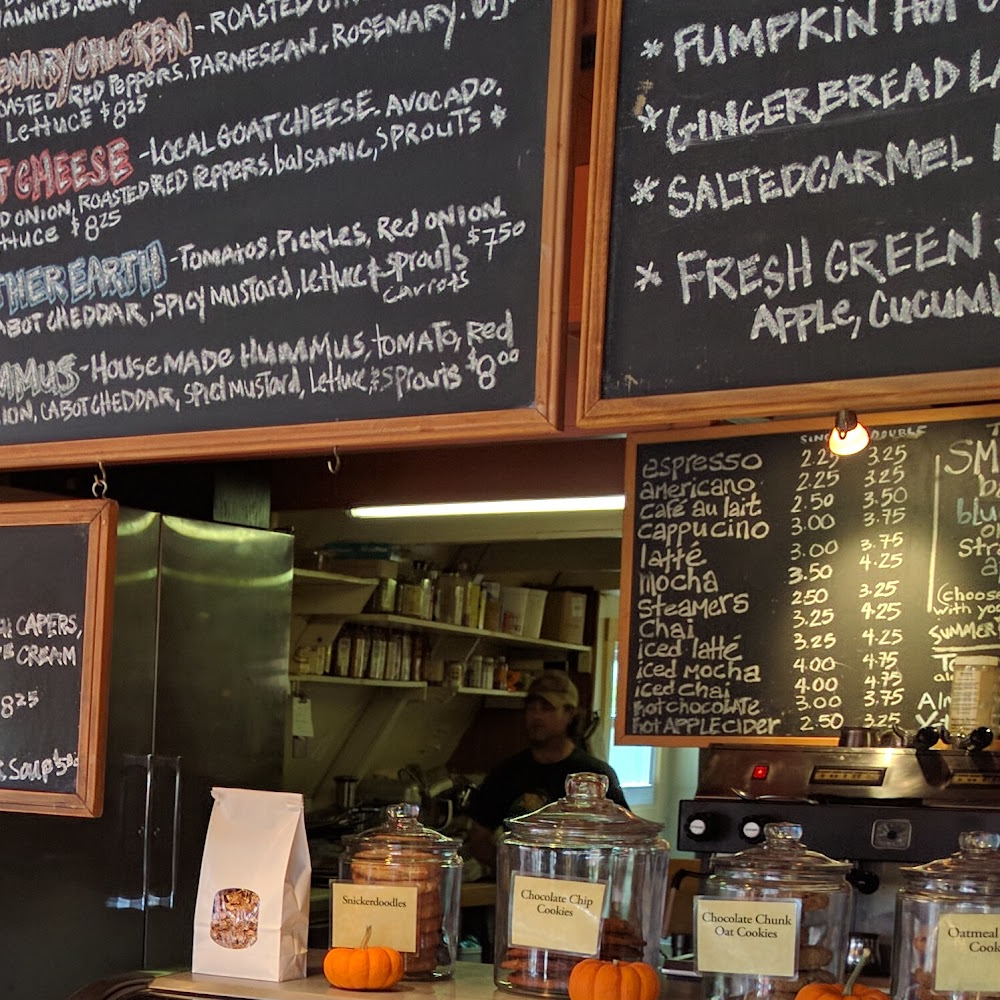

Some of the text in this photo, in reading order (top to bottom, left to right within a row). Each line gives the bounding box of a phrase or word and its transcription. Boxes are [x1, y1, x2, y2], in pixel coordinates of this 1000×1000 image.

[15, 137, 133, 201] CHEESE
[149, 131, 216, 166] LOCAL
[78, 180, 149, 213] ROASTED
[150, 167, 187, 196] RED
[677, 212, 981, 305] FRESH GREEN
[68, 239, 167, 303] EARTH
[41, 397, 90, 421] CABOT
[872, 427, 927, 441] DOUBLE
[642, 453, 763, 481] espresso
[693, 500, 718, 517] au
[724, 496, 762, 519] lait
[17, 644, 77, 667] CREAM
[637, 640, 681, 660] iced
[634, 681, 675, 698] iced
[342, 895, 407, 908] Snickerdoodles
[521, 889, 593, 906] Chocolate Chip
[536, 904, 574, 917] Cookies
[702, 912, 792, 926] Chocolate Chunk
[714, 926, 778, 938] Oat Cookies
[948, 927, 998, 938] Oatmeal
